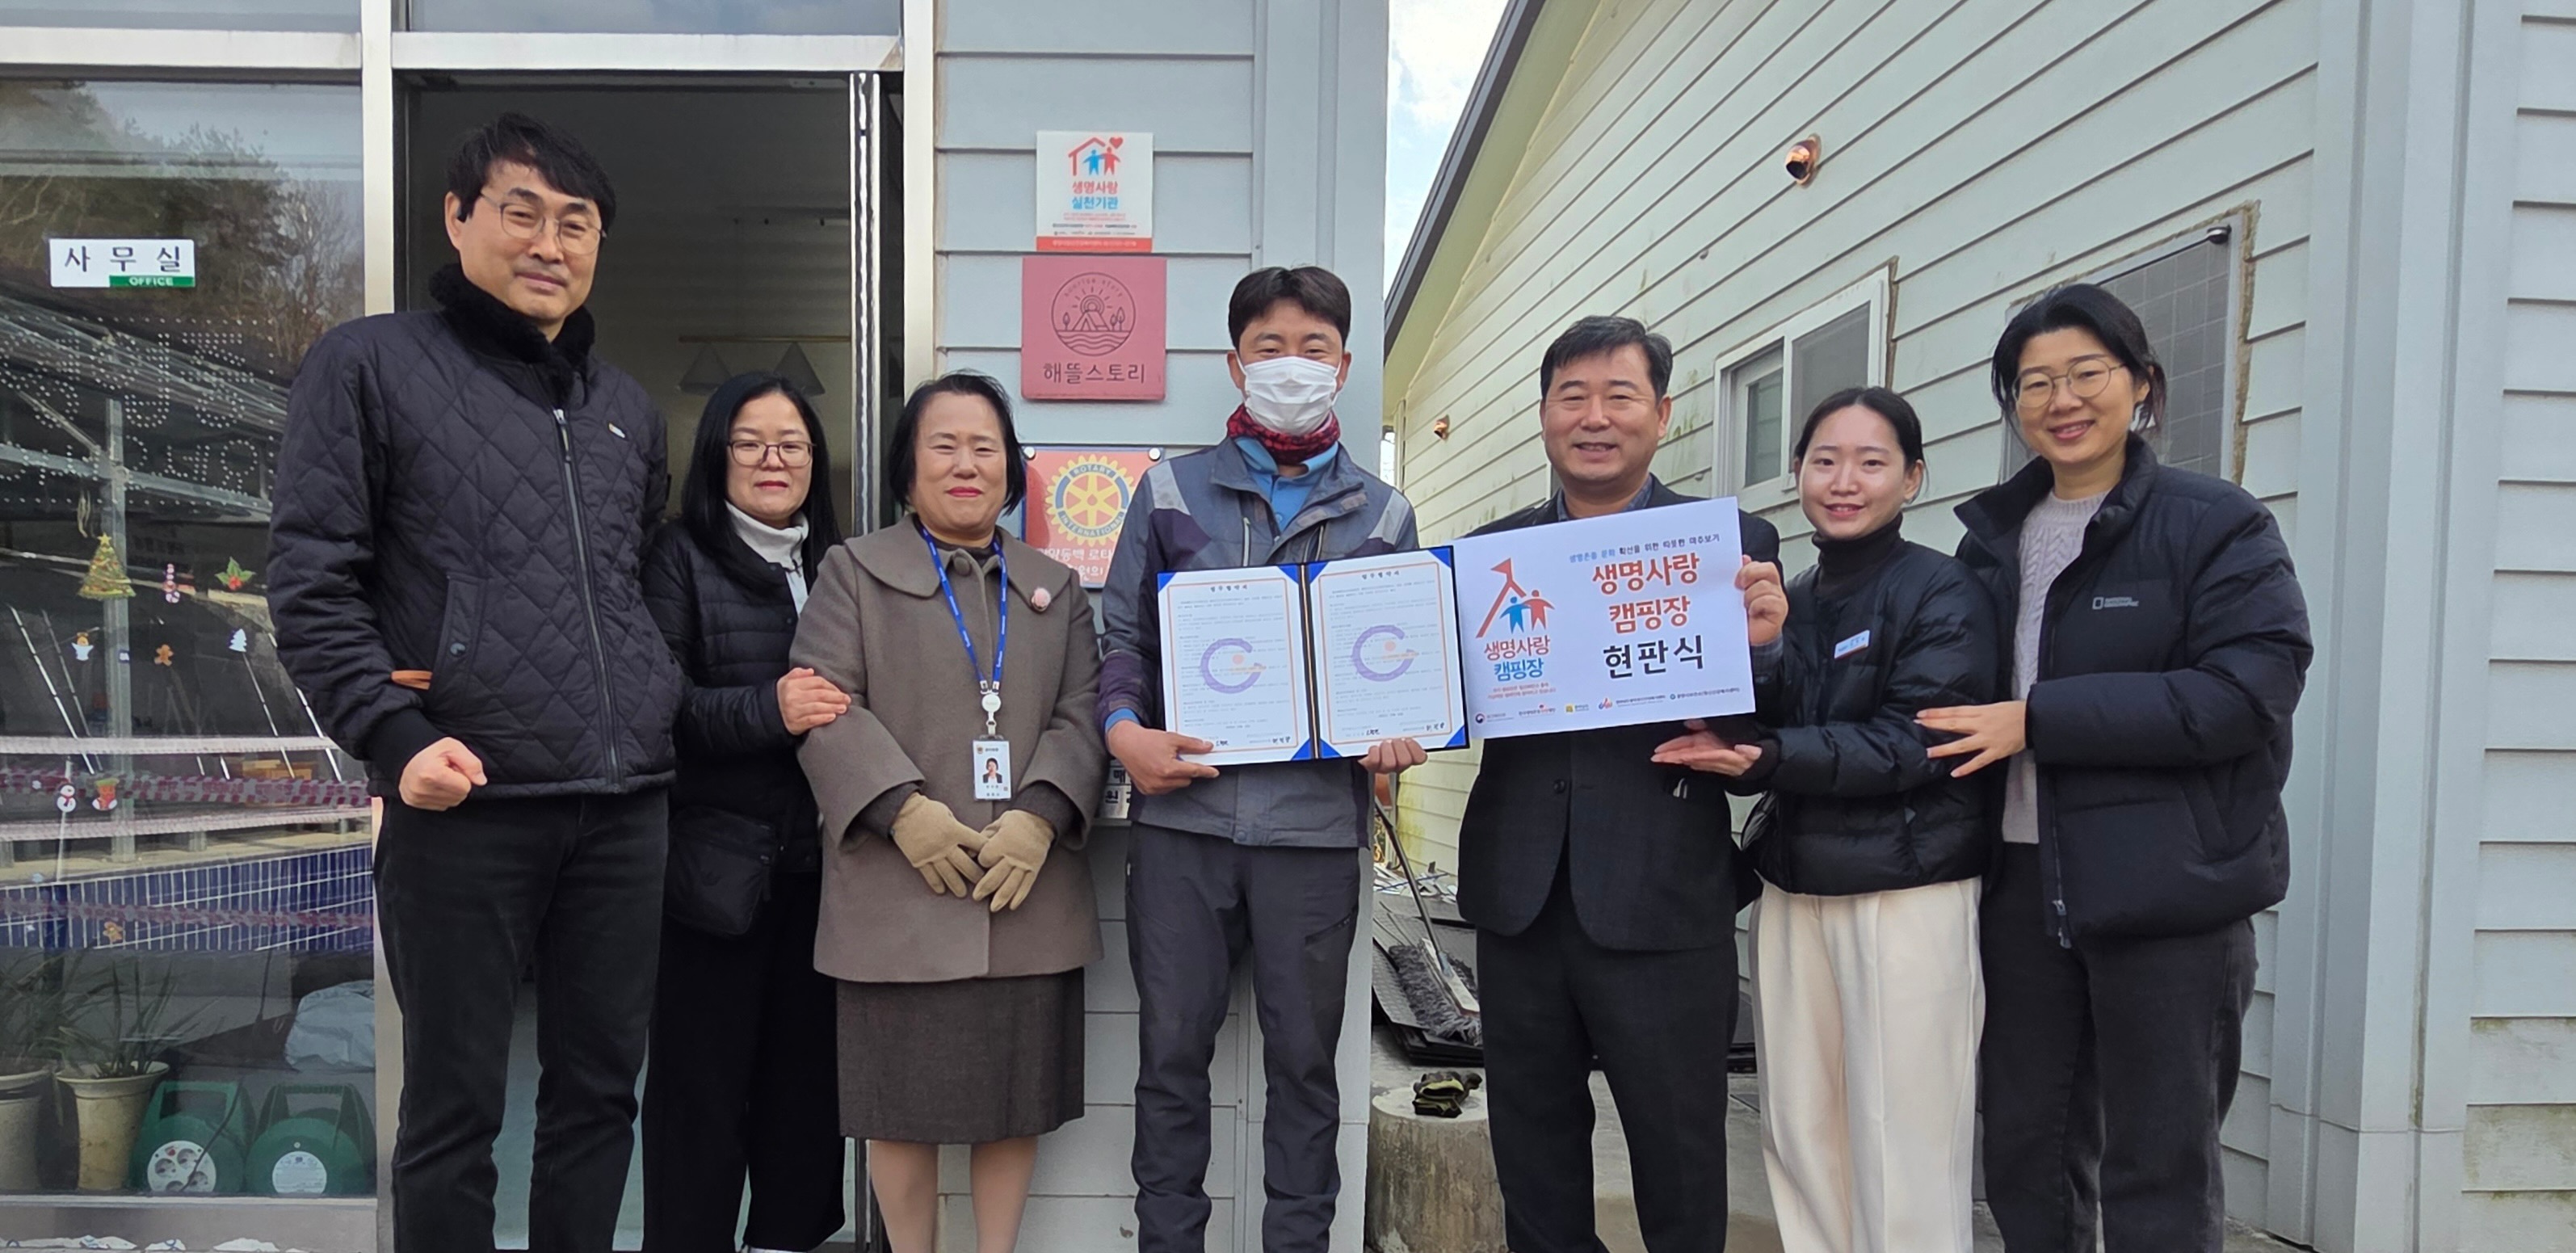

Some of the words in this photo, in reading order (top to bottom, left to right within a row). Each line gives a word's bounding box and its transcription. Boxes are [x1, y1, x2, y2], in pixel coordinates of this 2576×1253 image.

[1072, 181, 1118, 195] 생명사랑
[1072, 196, 1118, 209] 실천기관
[65, 246, 180, 272] 사무실
[128, 276, 174, 286] OFFICE
[1043, 363, 1145, 385] 해뜰스토리
[1074, 465, 1112, 476] ROTARY
[1061, 513, 1124, 537] INTERNATIONAL
[1087, 549, 1114, 561] 로타
[1645, 542, 1659, 552] 위한
[1662, 538, 1686, 548] 따뜻한
[1592, 553, 1700, 595] 생명사랑
[1608, 595, 1691, 634] 캠핑장
[1483, 635, 1550, 661] 생명사랑
[1603, 635, 1704, 679] 현판식
[1494, 658, 1544, 682] 캠핑장
